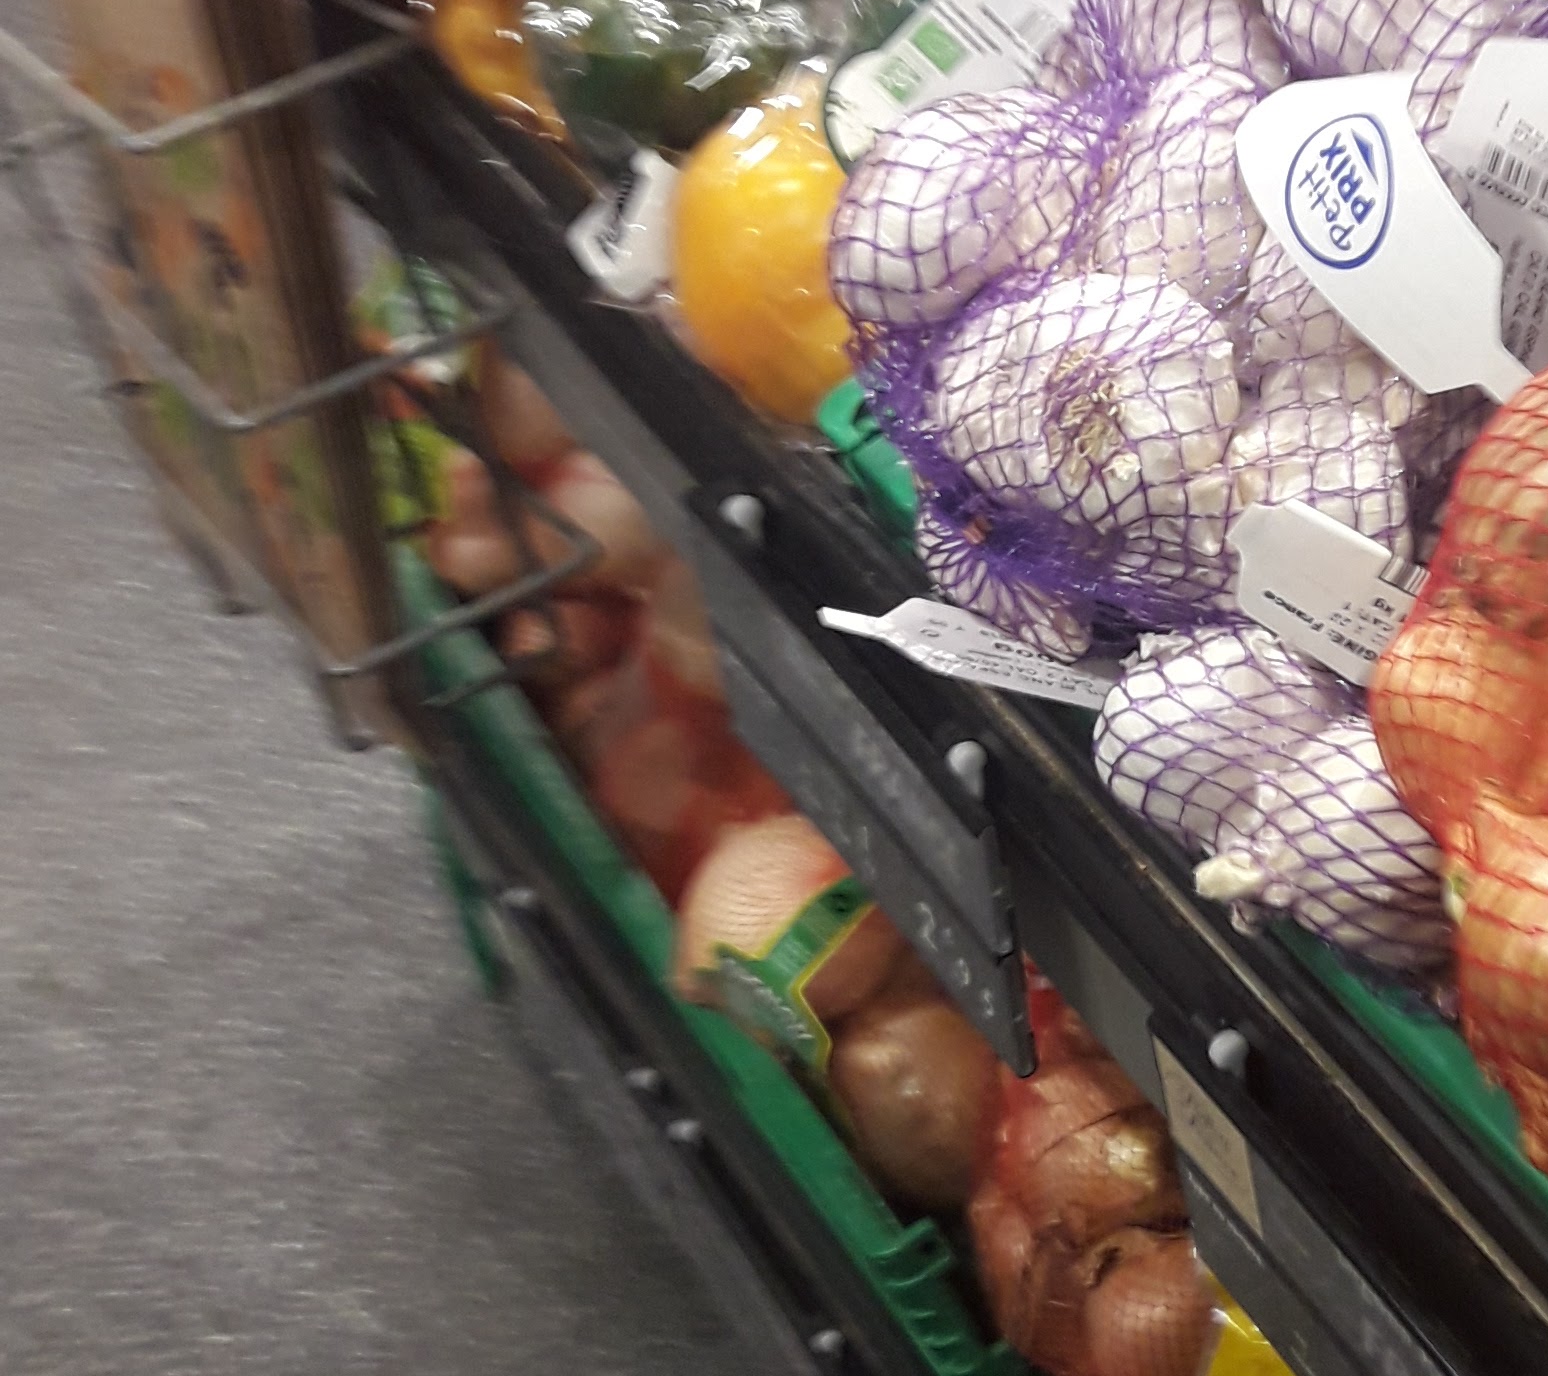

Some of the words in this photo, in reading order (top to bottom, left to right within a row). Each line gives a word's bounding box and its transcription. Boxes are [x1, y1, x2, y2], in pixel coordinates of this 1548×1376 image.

[1299, 163, 1352, 251] Petit
[1320, 132, 1375, 224] PRIX
[1264, 590, 1324, 631] France
[1328, 629, 1379, 661] GINE:
